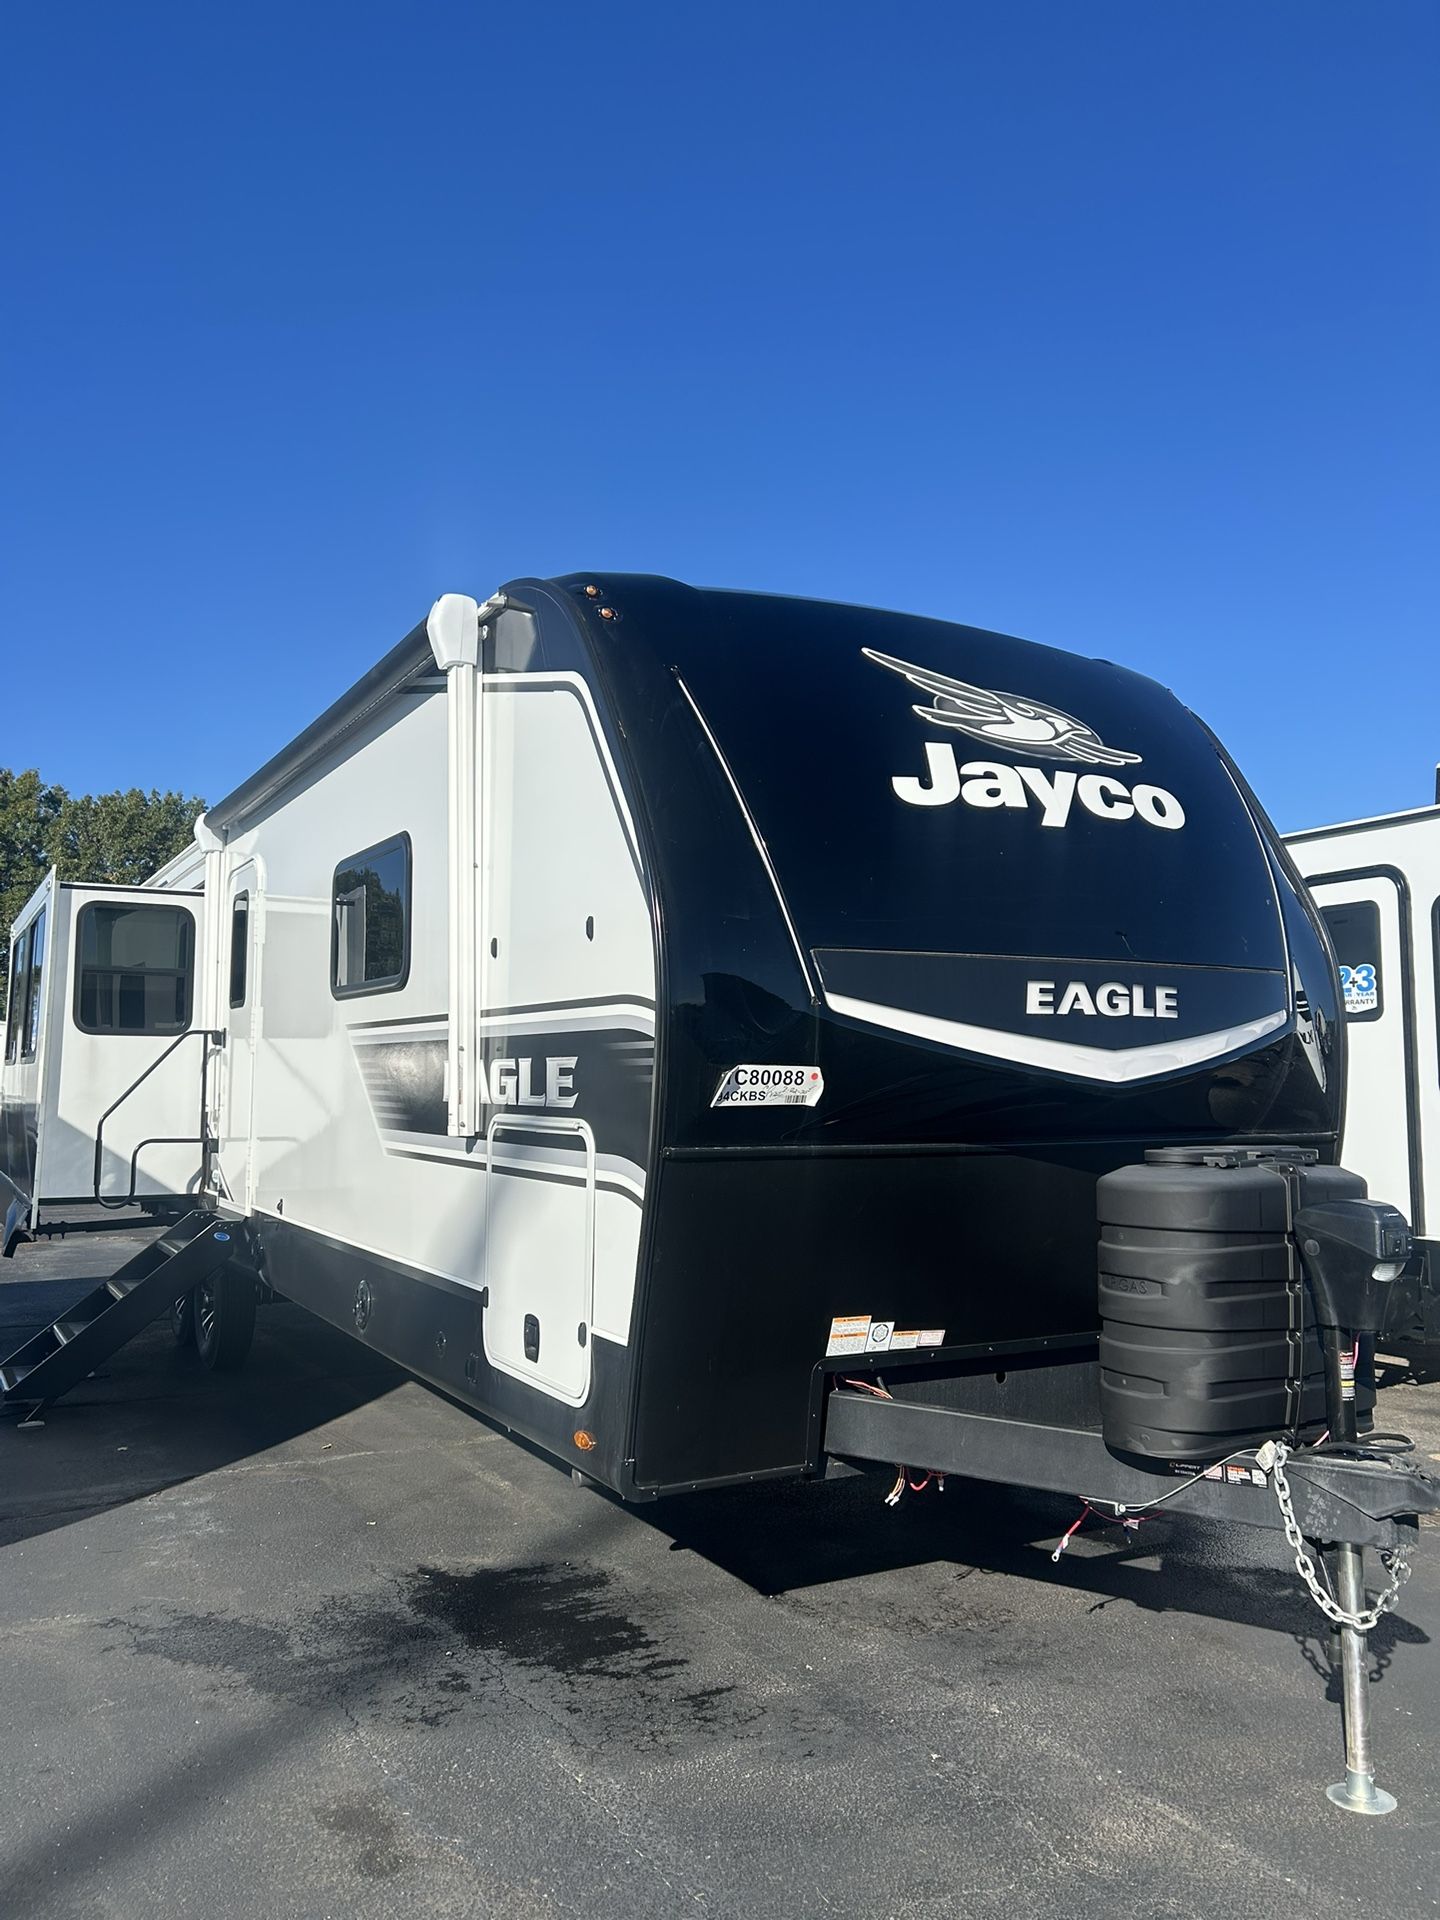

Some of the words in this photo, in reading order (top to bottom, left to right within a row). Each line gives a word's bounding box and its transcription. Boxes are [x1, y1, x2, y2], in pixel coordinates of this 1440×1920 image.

[891, 742, 1186, 830] Jayco
[1026, 981, 1179, 1019] EAGLE
[443, 1056, 579, 1108] GLE
[726, 1069, 805, 1086] C80088
[1119, 1278, 1148, 1295] GAS
